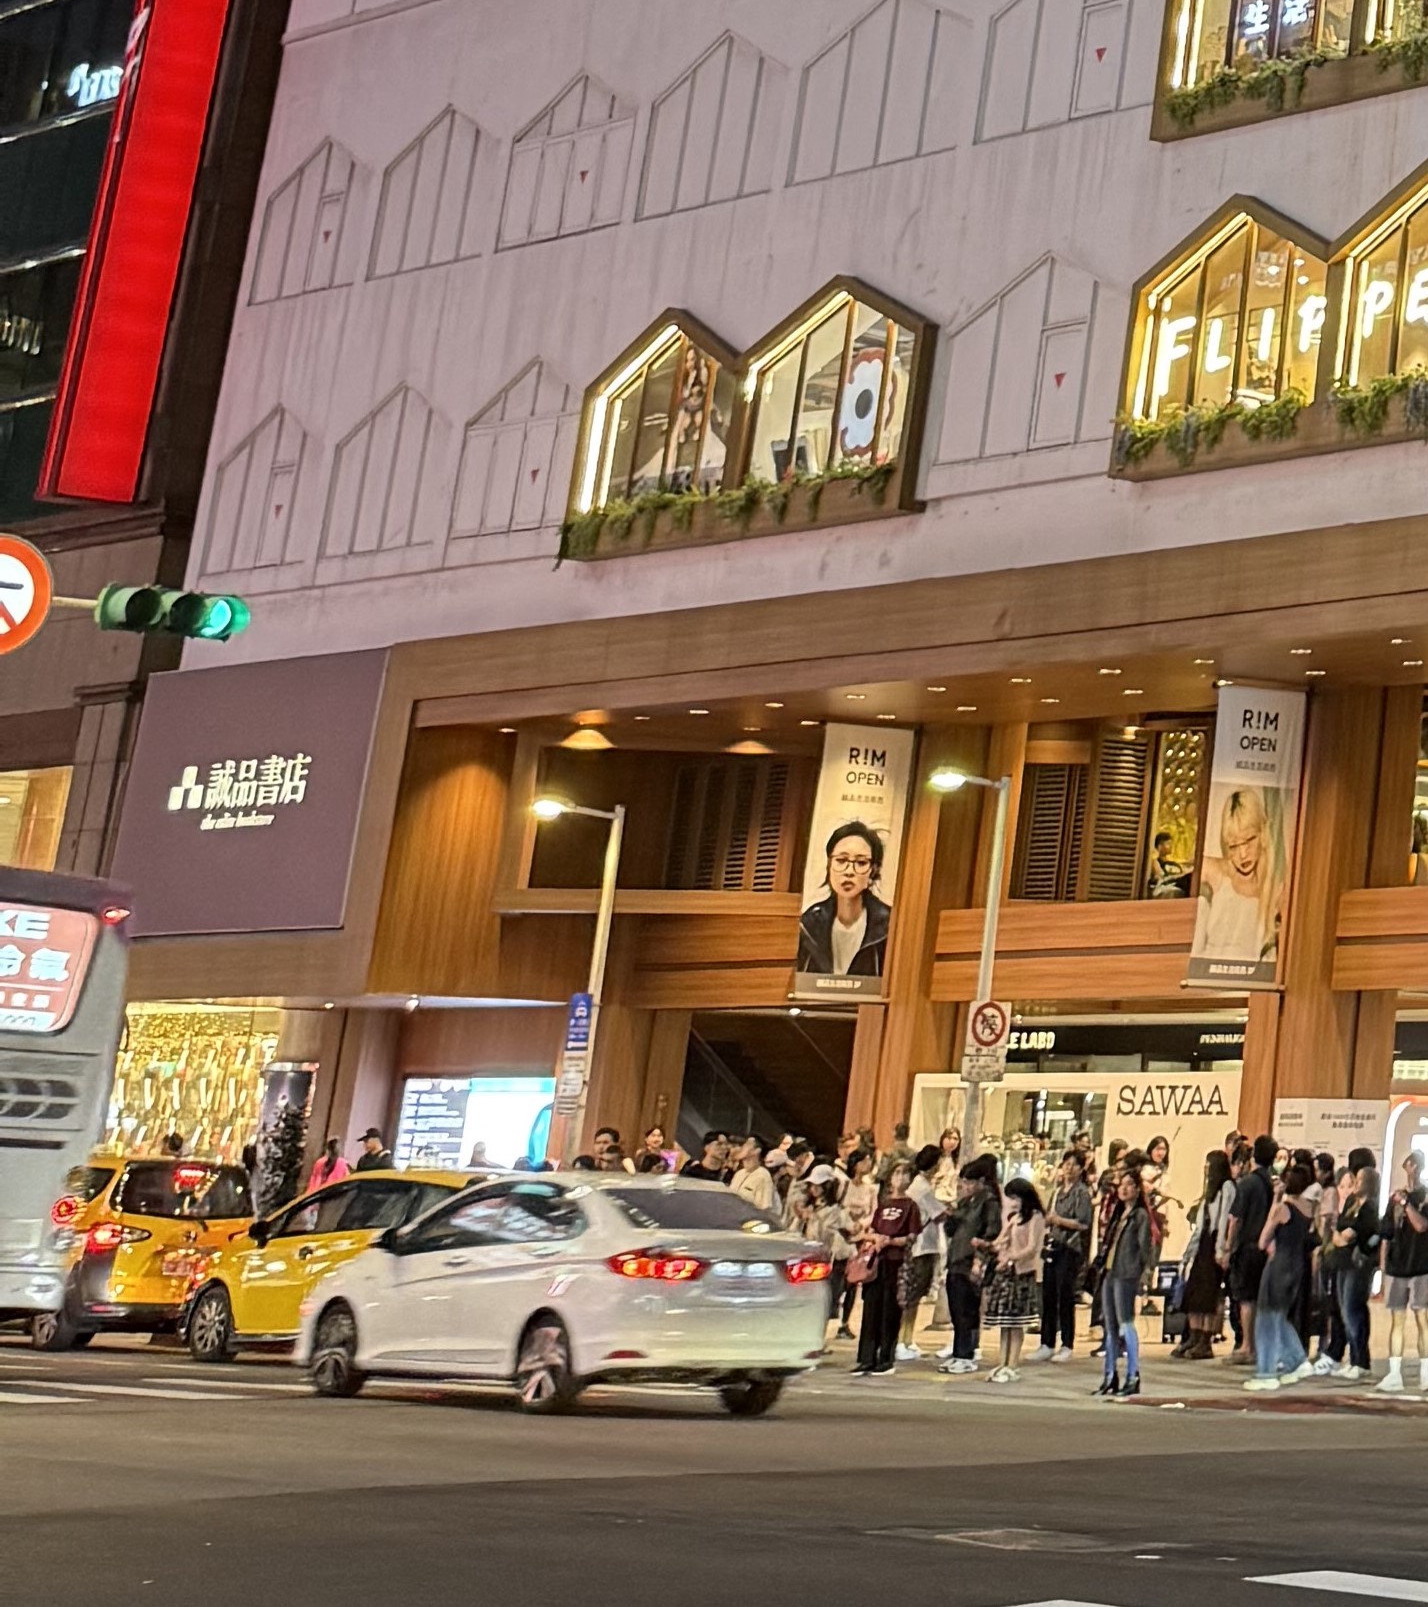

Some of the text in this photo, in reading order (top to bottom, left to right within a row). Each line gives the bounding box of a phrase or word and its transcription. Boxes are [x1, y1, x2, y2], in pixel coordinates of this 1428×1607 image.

[1239, 735, 1277, 752] OPEN
[204, 753, 312, 810] 誠品書店
[845, 770, 885, 787] OPEN
[1116, 1084, 1229, 1117] SAWAA
